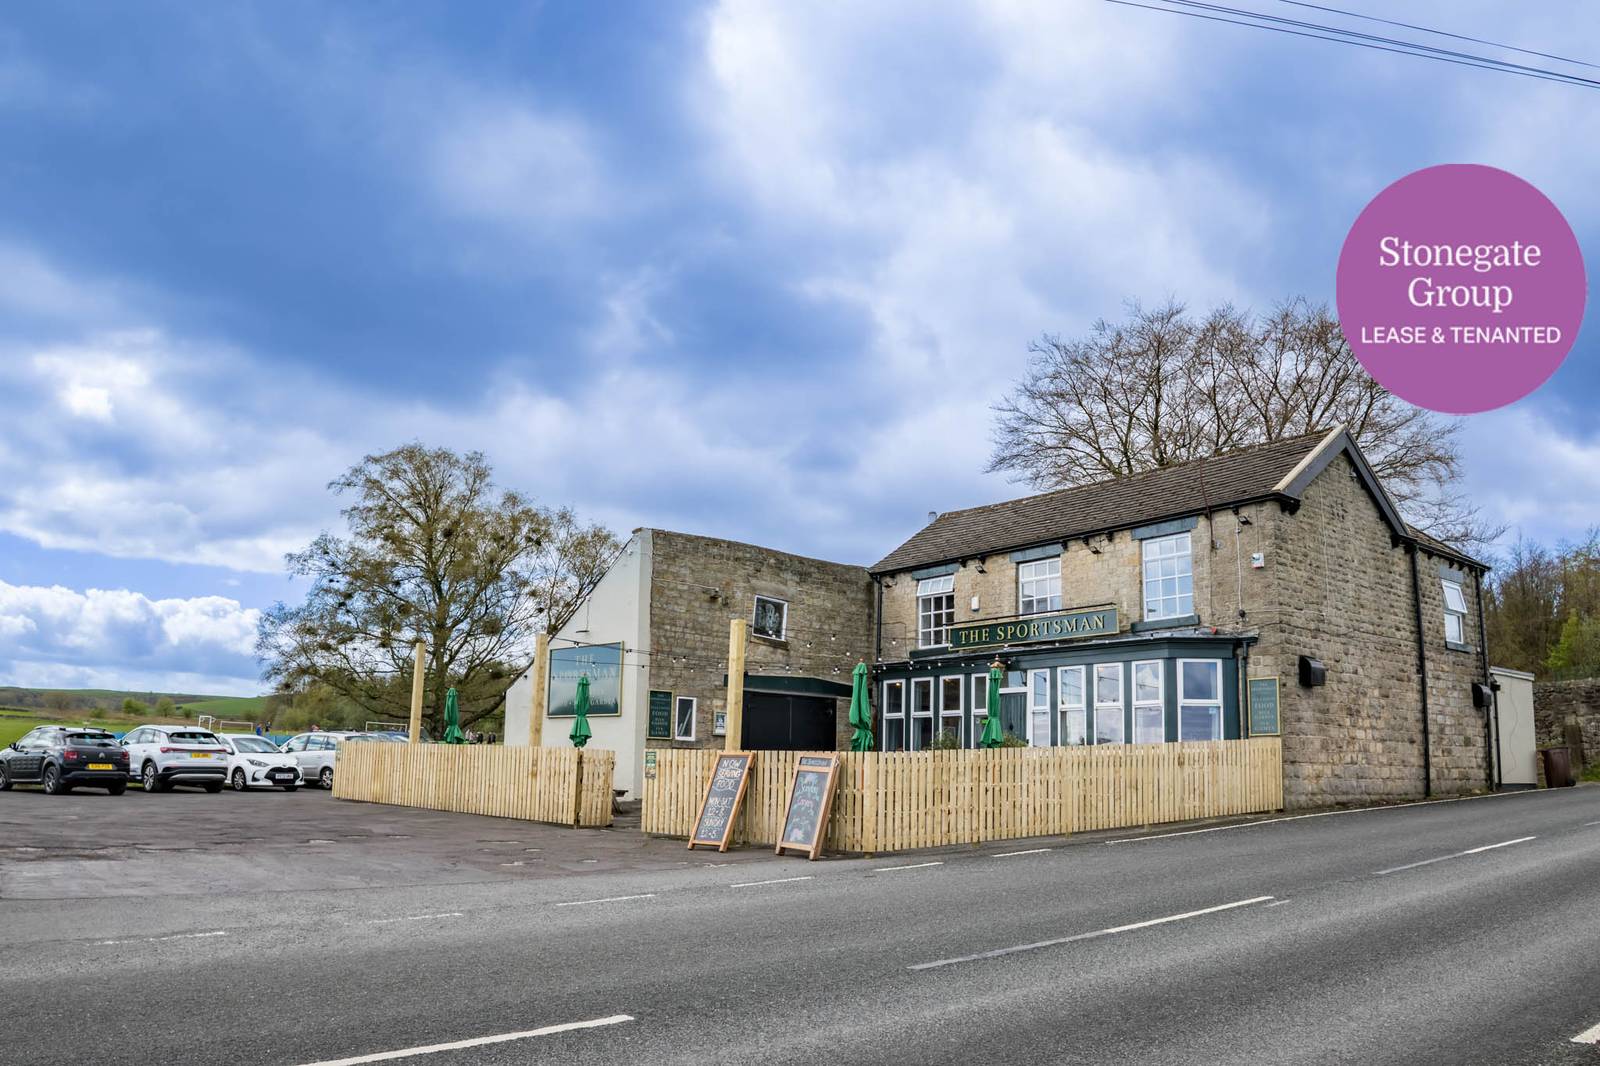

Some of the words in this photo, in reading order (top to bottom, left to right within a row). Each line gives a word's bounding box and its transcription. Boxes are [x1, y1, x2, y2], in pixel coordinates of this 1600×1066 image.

[959, 628, 990, 644] THE
[997, 614, 1106, 640] SPORTSMAN
[722, 759, 743, 769] NOW
